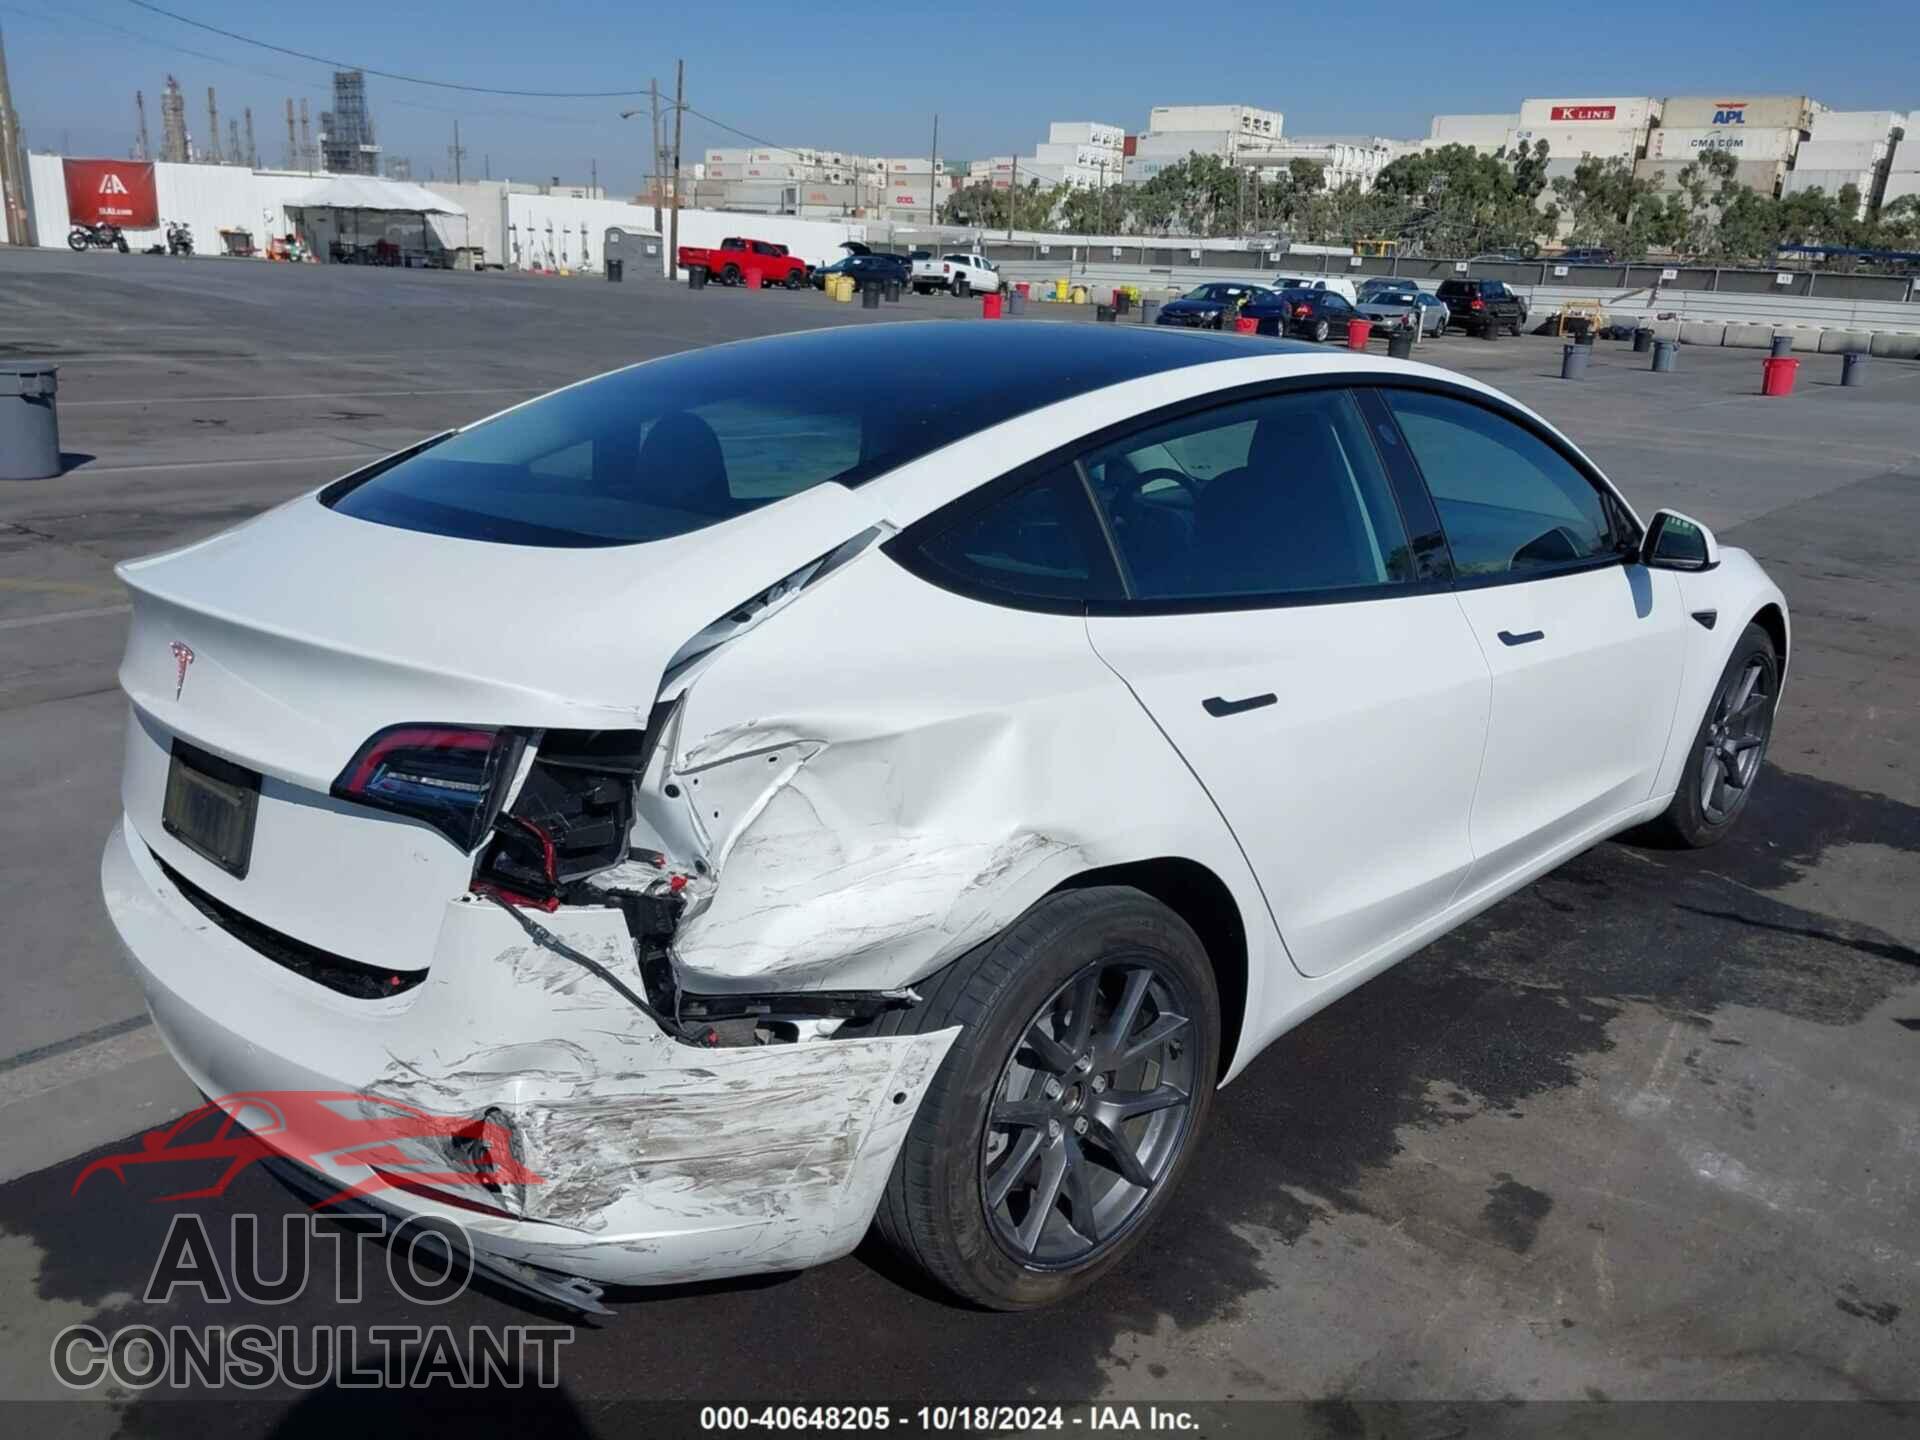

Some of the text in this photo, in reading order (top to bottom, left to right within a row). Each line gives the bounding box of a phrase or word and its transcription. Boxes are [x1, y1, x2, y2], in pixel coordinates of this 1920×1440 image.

[1562, 108, 1610, 119] K LINE
[1712, 110, 1745, 124] APL
[1690, 139, 1744, 147] CMA CGM
